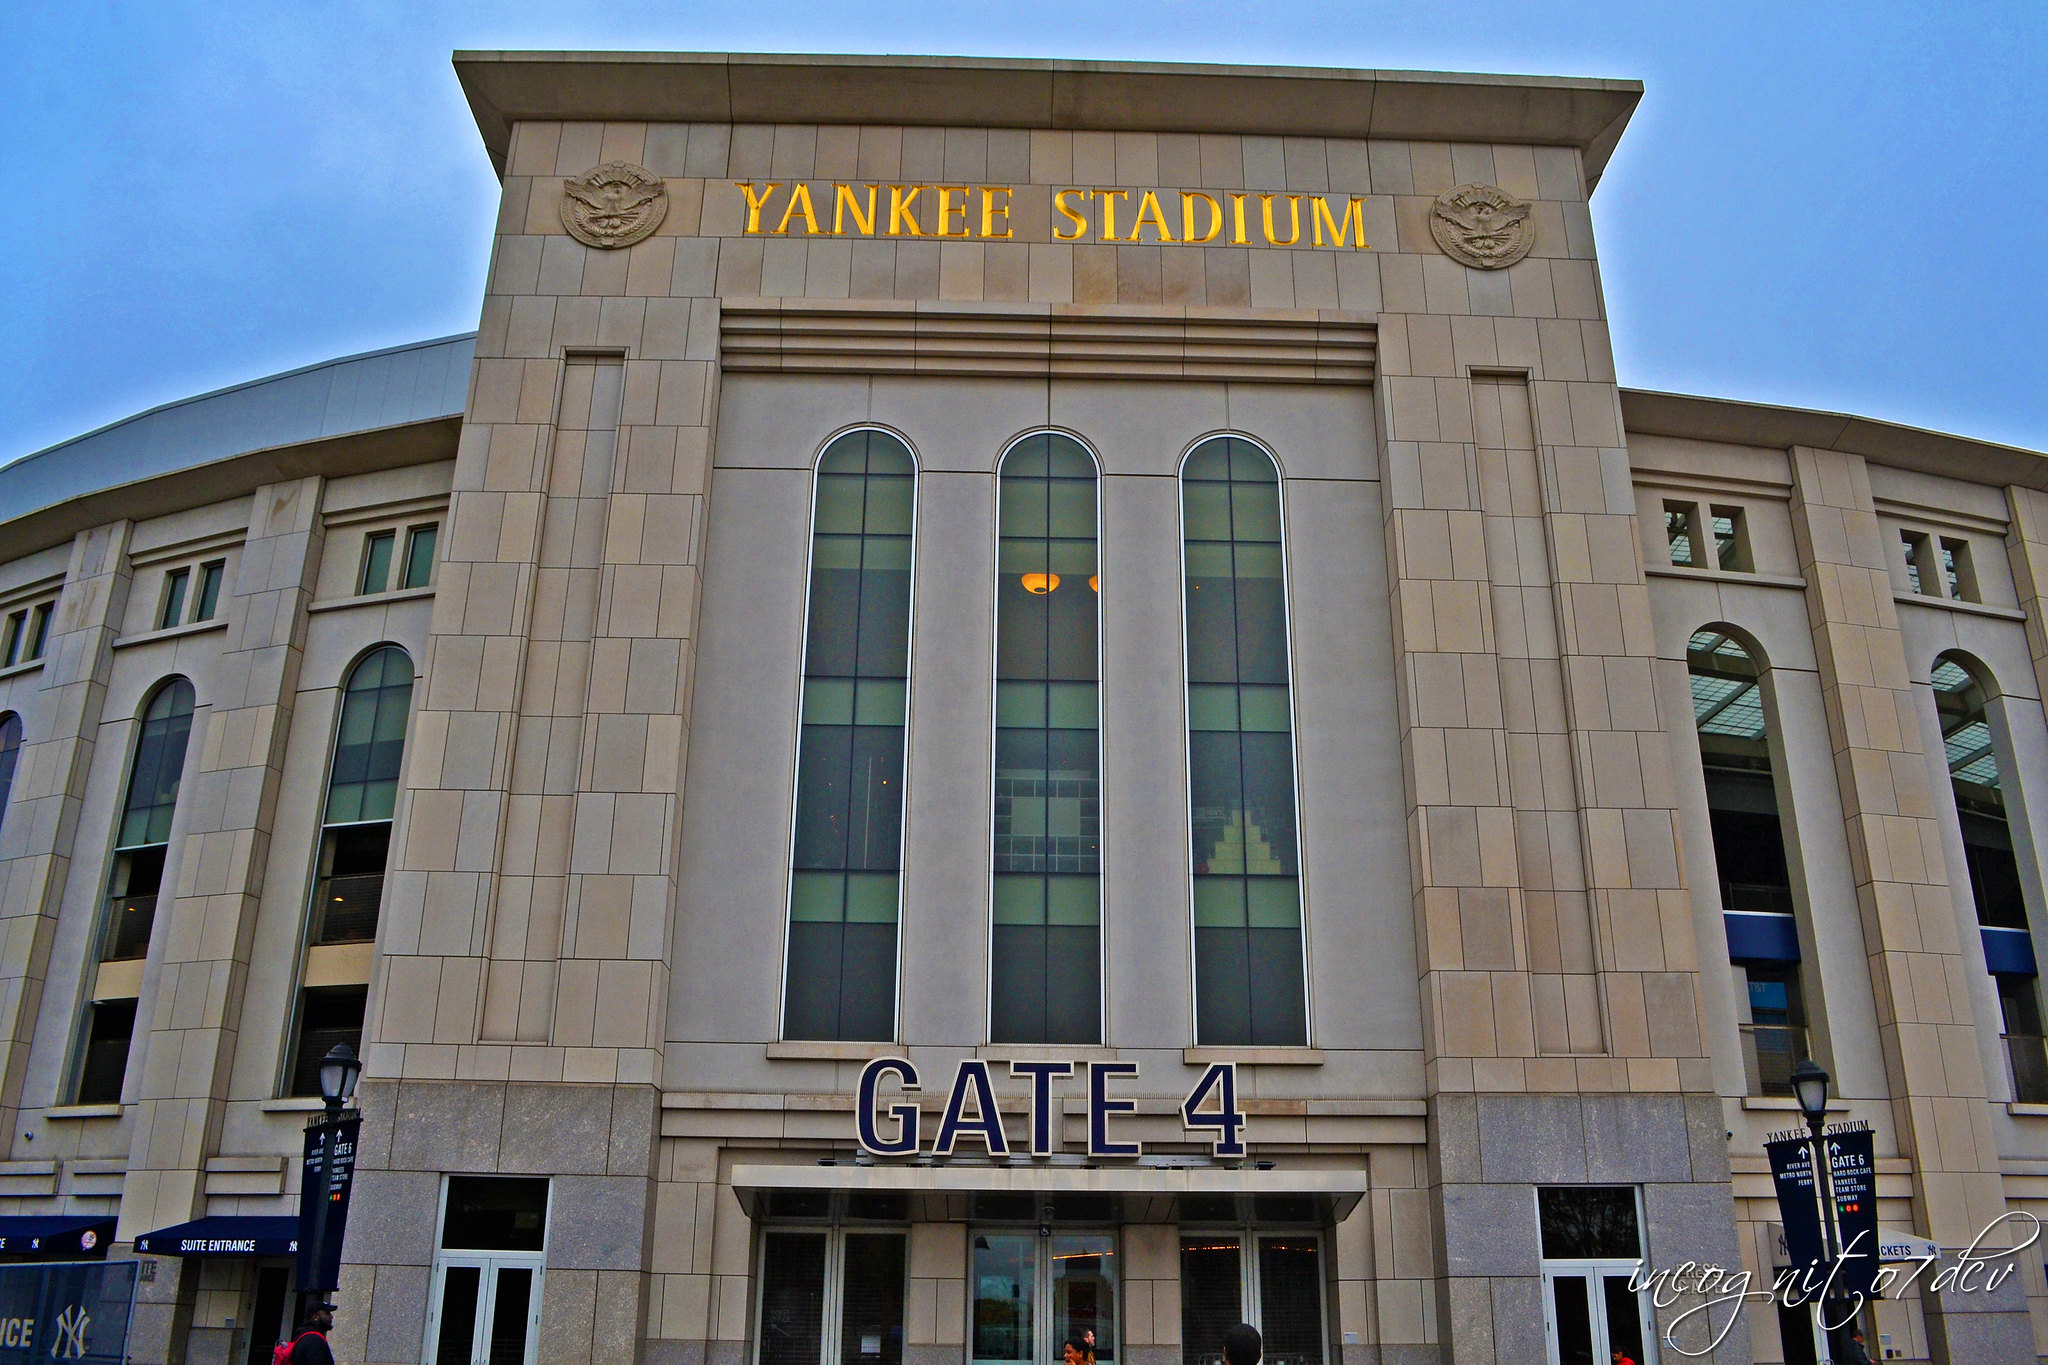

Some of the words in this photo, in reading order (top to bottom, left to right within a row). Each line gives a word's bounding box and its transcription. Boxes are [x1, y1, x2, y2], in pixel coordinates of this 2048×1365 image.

[733, 182, 1013, 238] YANKEE
[1053, 189, 1371, 248] STADIUM
[855, 1055, 1142, 1158] GATE
[1179, 1061, 1247, 1158] 4
[1767, 1128, 1806, 1143] YANKEE
[1827, 1120, 1870, 1135] STADIUM
[1787, 1162, 1800, 1170] RIVER
[1831, 1155, 1856, 1168] GATE
[1858, 1154, 1865, 1166] 6
[1796, 1170, 1812, 1178] NORTH
[1833, 1169, 1846, 1177] HARD
[1847, 1168, 1860, 1176] ROCK
[1860, 1167, 1872, 1175] CAFE
[1834, 1178, 1857, 1186] YANKEES
[1835, 1185, 1850, 1193] TEAM
[1850, 1184, 1867, 1192] STORE
[1836, 1194, 1858, 1203] SUBWAY
[181, 1239, 207, 1252] SUITE
[208, 1239, 256, 1252] ENTRANCE
